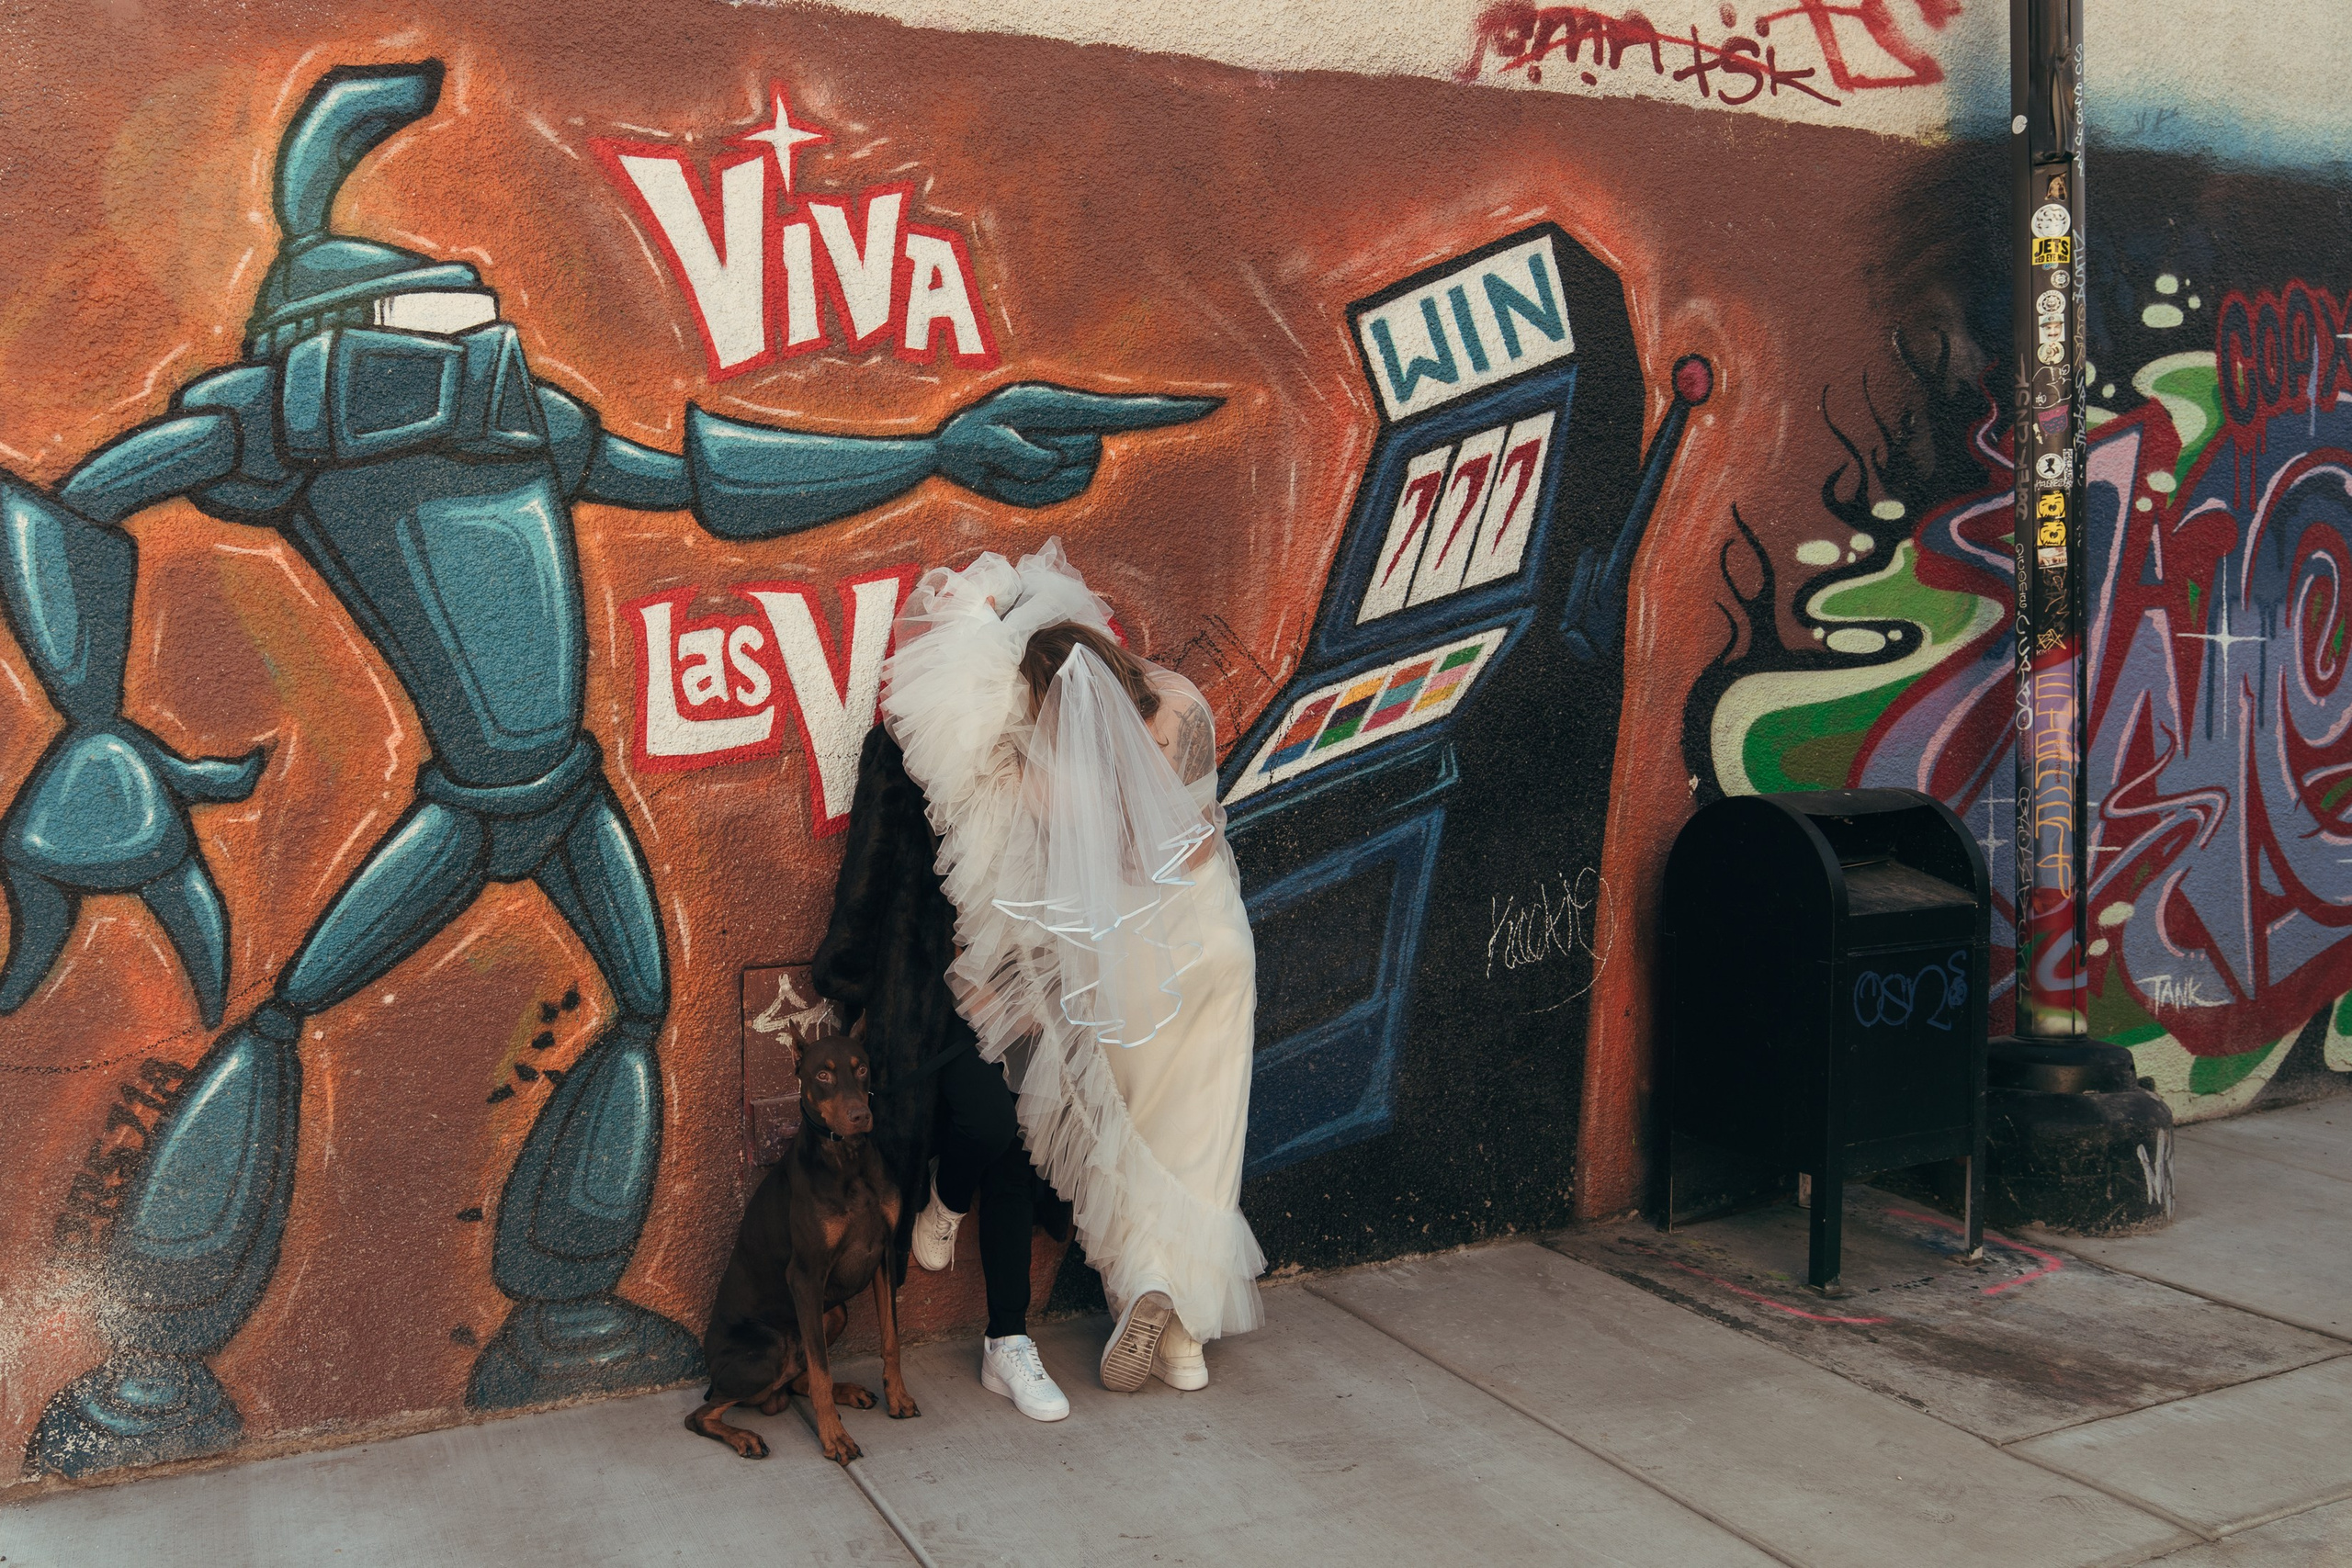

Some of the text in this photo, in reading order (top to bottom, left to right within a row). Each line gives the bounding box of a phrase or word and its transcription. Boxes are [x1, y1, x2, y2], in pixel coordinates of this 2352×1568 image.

[2034, 238, 2069, 257] JETS
[1369, 253, 1566, 404] WIN
[2133, 974, 2230, 1016] TANK
